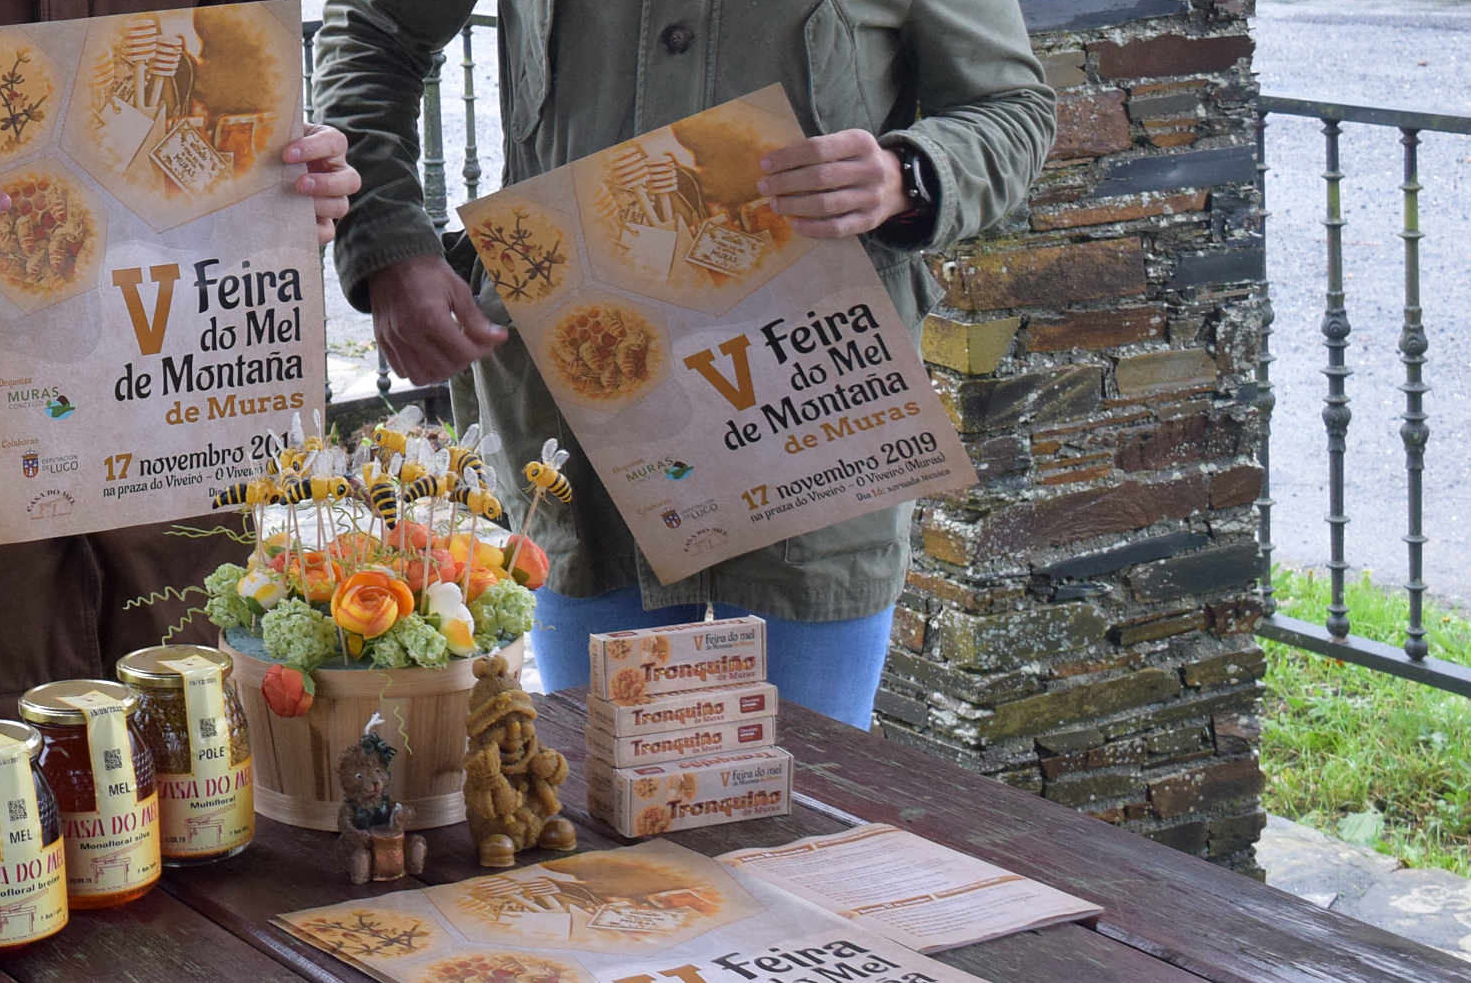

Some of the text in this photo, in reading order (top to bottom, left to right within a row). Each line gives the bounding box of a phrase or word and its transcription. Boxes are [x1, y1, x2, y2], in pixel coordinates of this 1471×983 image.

[112, 258, 303, 356] V Feira
[200, 306, 301, 352] do Mel
[683, 303, 880, 412] V Feira
[790, 333, 892, 391] do Mel
[115, 352, 303, 401] de Montaña
[7, 386, 59, 403] MURAS
[165, 392, 304, 425] de Muras
[723, 371, 910, 451] de Montaña
[783, 400, 922, 455] de Muras
[50, 460, 79, 474] LUGO
[103, 430, 289, 481] 17 novembro 201
[625, 456, 675, 482] MURAS
[740, 483, 770, 511] 17
[776, 455, 879, 500] novembro
[880, 431, 938, 465] 2019
[103, 487, 116, 497] na
[117, 482, 148, 499] praza
[150, 478, 163, 490] do
[215, 467, 224, 480] O
[750, 511, 764, 523] na
[764, 502, 795, 521] praza
[795, 494, 808, 507] do
[856, 476, 866, 487] O
[905, 452, 946, 474] (Muras)
[199, 746, 225, 761] POLE
[108, 782, 131, 797] MEL
[190, 795, 236, 809] Multifloral
[206, 776, 230, 797] DO
[9, 829, 33, 845] MEL
[111, 812, 137, 835] DO
[80, 836, 132, 850] Monofloral
[16, 858, 42, 883] DO
[711, 940, 870, 980] Feira
[810, 954, 901, 983] Mel
